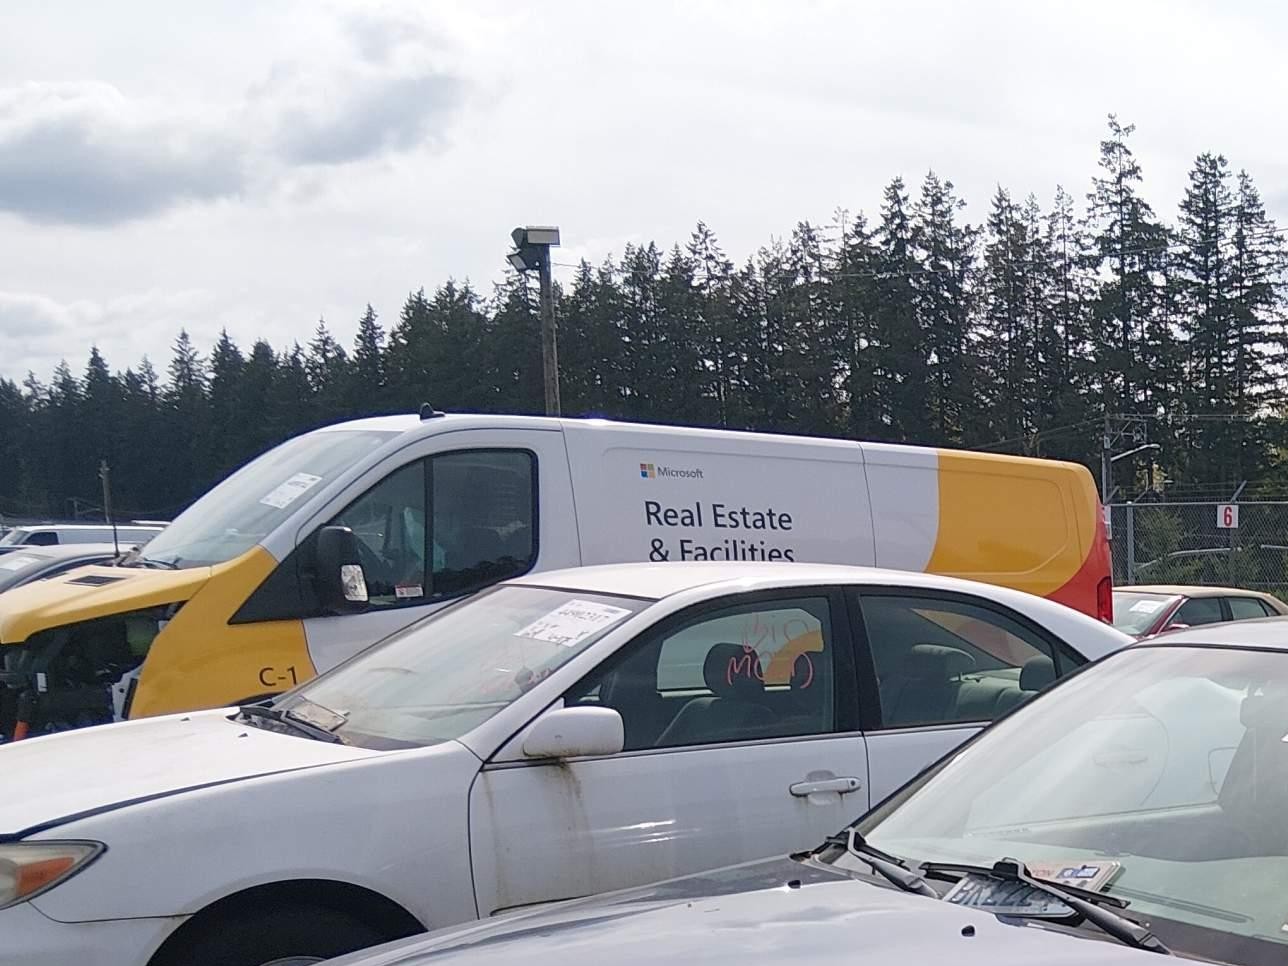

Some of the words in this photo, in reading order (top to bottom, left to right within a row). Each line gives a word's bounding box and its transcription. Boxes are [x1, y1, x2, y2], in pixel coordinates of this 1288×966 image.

[657, 466, 704, 479] Microsoft
[644, 500, 703, 527] Real
[712, 503, 793, 531] Estate
[1223, 506, 1233, 527] 6
[649, 537, 669, 562] &
[680, 538, 795, 562] Facilities
[258, 665, 297, 687] C-1
